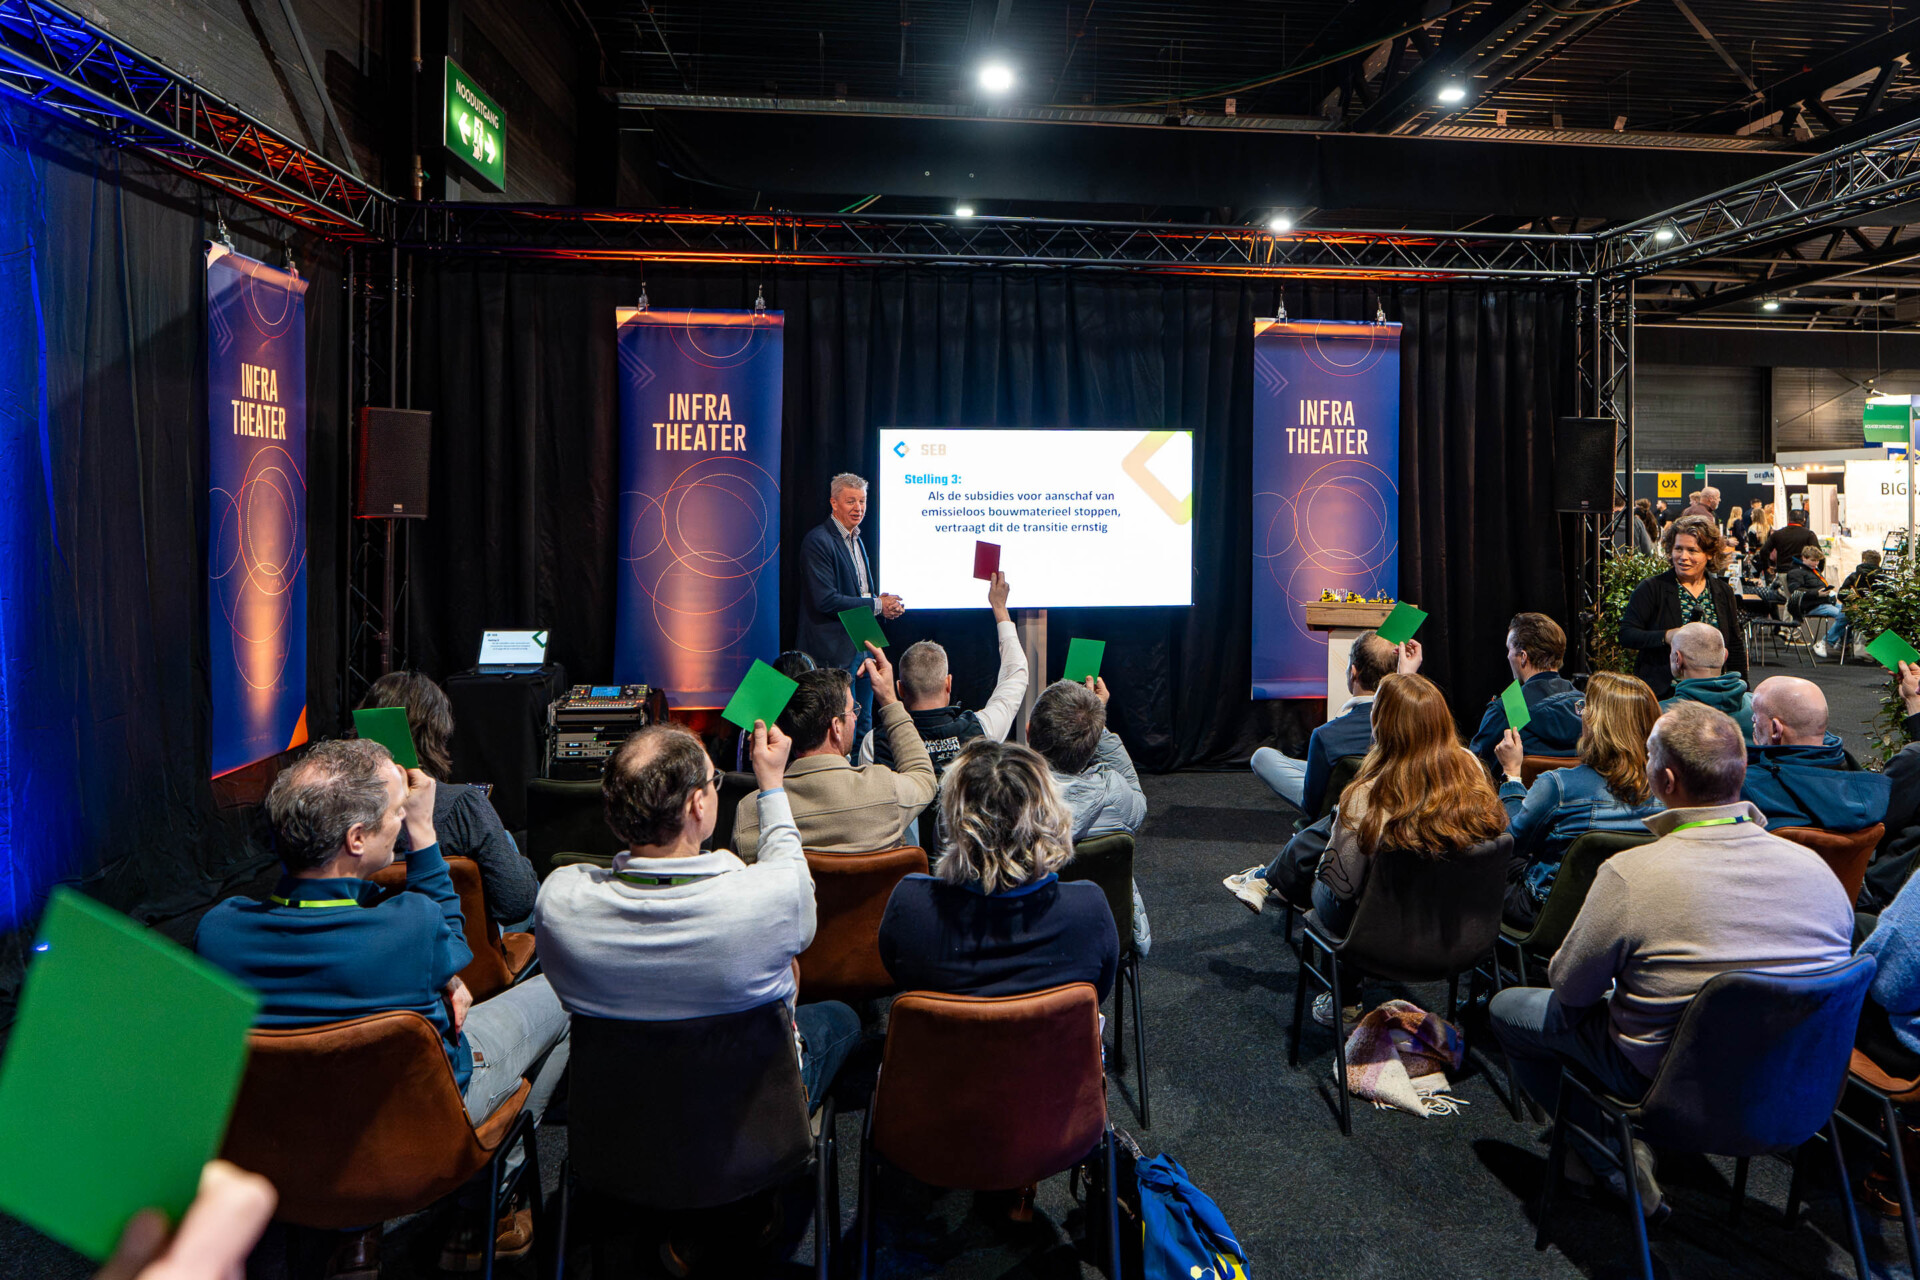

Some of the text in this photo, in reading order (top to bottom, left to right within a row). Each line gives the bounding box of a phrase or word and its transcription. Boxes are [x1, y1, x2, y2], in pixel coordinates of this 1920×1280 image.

[455, 78, 500, 129] NOODUITGANG
[241, 362, 279, 403] INFRA
[231, 399, 287, 441] THEATER
[668, 392, 732, 421] INFRA
[1300, 399, 1355, 426] INFRA
[652, 422, 747, 452] THEATER
[920, 443, 947, 456] SEB
[1285, 428, 1369, 455] THEATER
[904, 473, 962, 486] Stelling 3:
[927, 490, 1115, 501] Als de subsidies voor aanschaf van
[921, 506, 1121, 519] emissieloos bouwmaterieel stoppen,
[934, 522, 1108, 535] vertraagt dit de transitie ernstig
